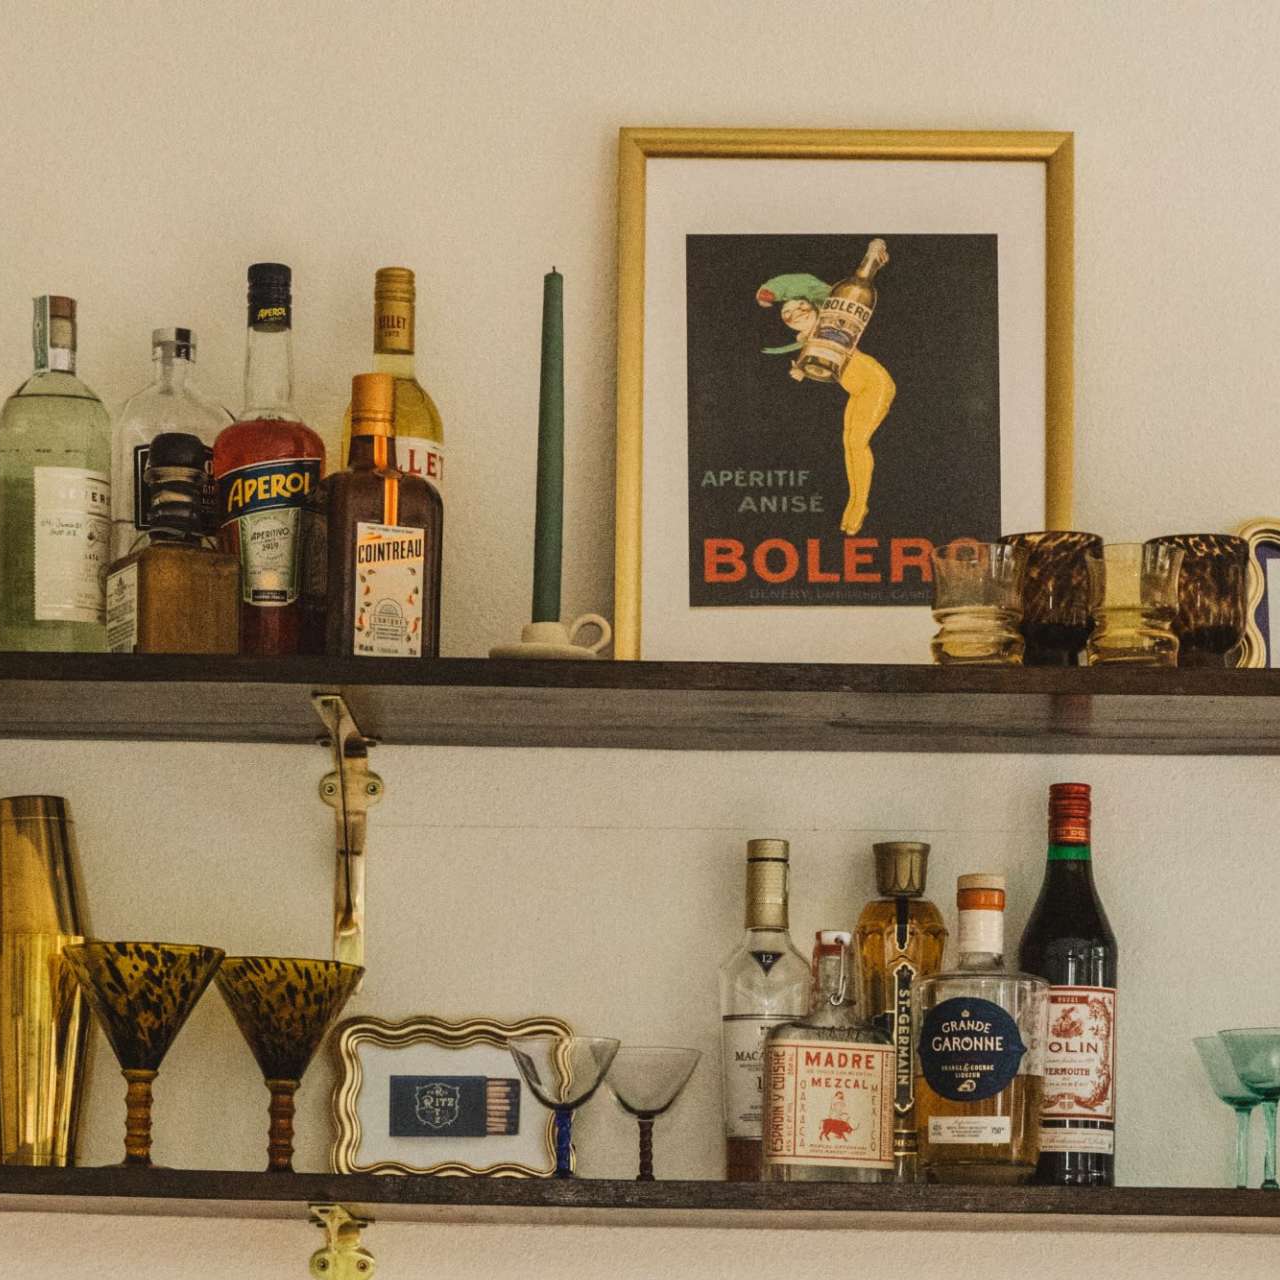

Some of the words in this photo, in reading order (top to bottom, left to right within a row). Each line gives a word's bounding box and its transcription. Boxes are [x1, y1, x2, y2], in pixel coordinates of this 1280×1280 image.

[822, 298, 871, 323] BOLERO
[357, 538, 422, 563] COINTREAU
[703, 537, 989, 584] BOLERO
[762, 954, 773, 963] 12
[941, 1020, 992, 1034] GRANDE
[897, 988, 910, 1085] ST-GERMAIN
[931, 1036, 1004, 1052] GARONNE
[1048, 1041, 1098, 1053] OLIN
[805, 1051, 875, 1070] MADRE
[811, 1077, 868, 1090] MEZCAL
[773, 1094, 784, 1102] Y
